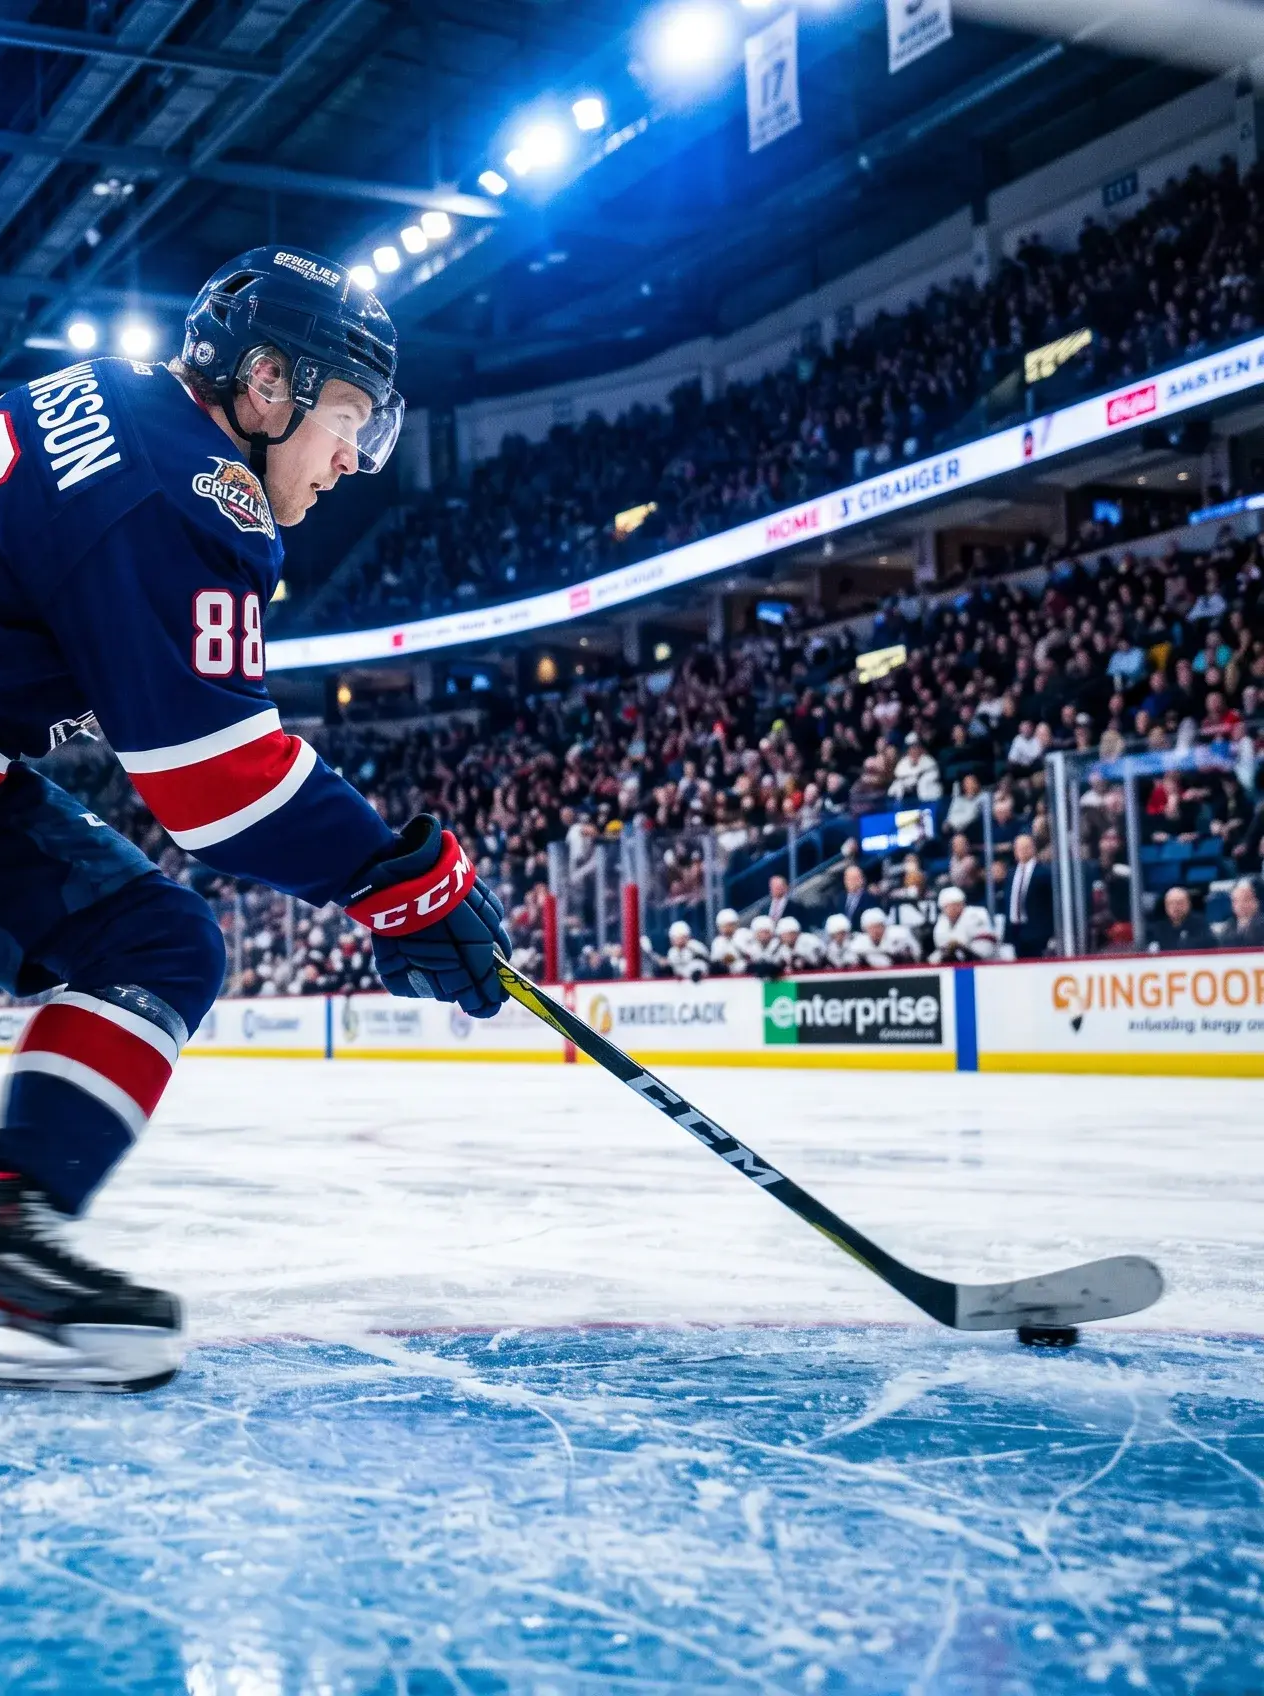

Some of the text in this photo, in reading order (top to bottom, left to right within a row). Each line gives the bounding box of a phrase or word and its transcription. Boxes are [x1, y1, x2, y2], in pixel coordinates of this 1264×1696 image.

[766, 508, 820, 543] HOME
[192, 588, 265, 680] 88
[370, 845, 471, 930] CCM
[769, 987, 939, 1035] enterprise
[626, 1071, 785, 1186] CCM
